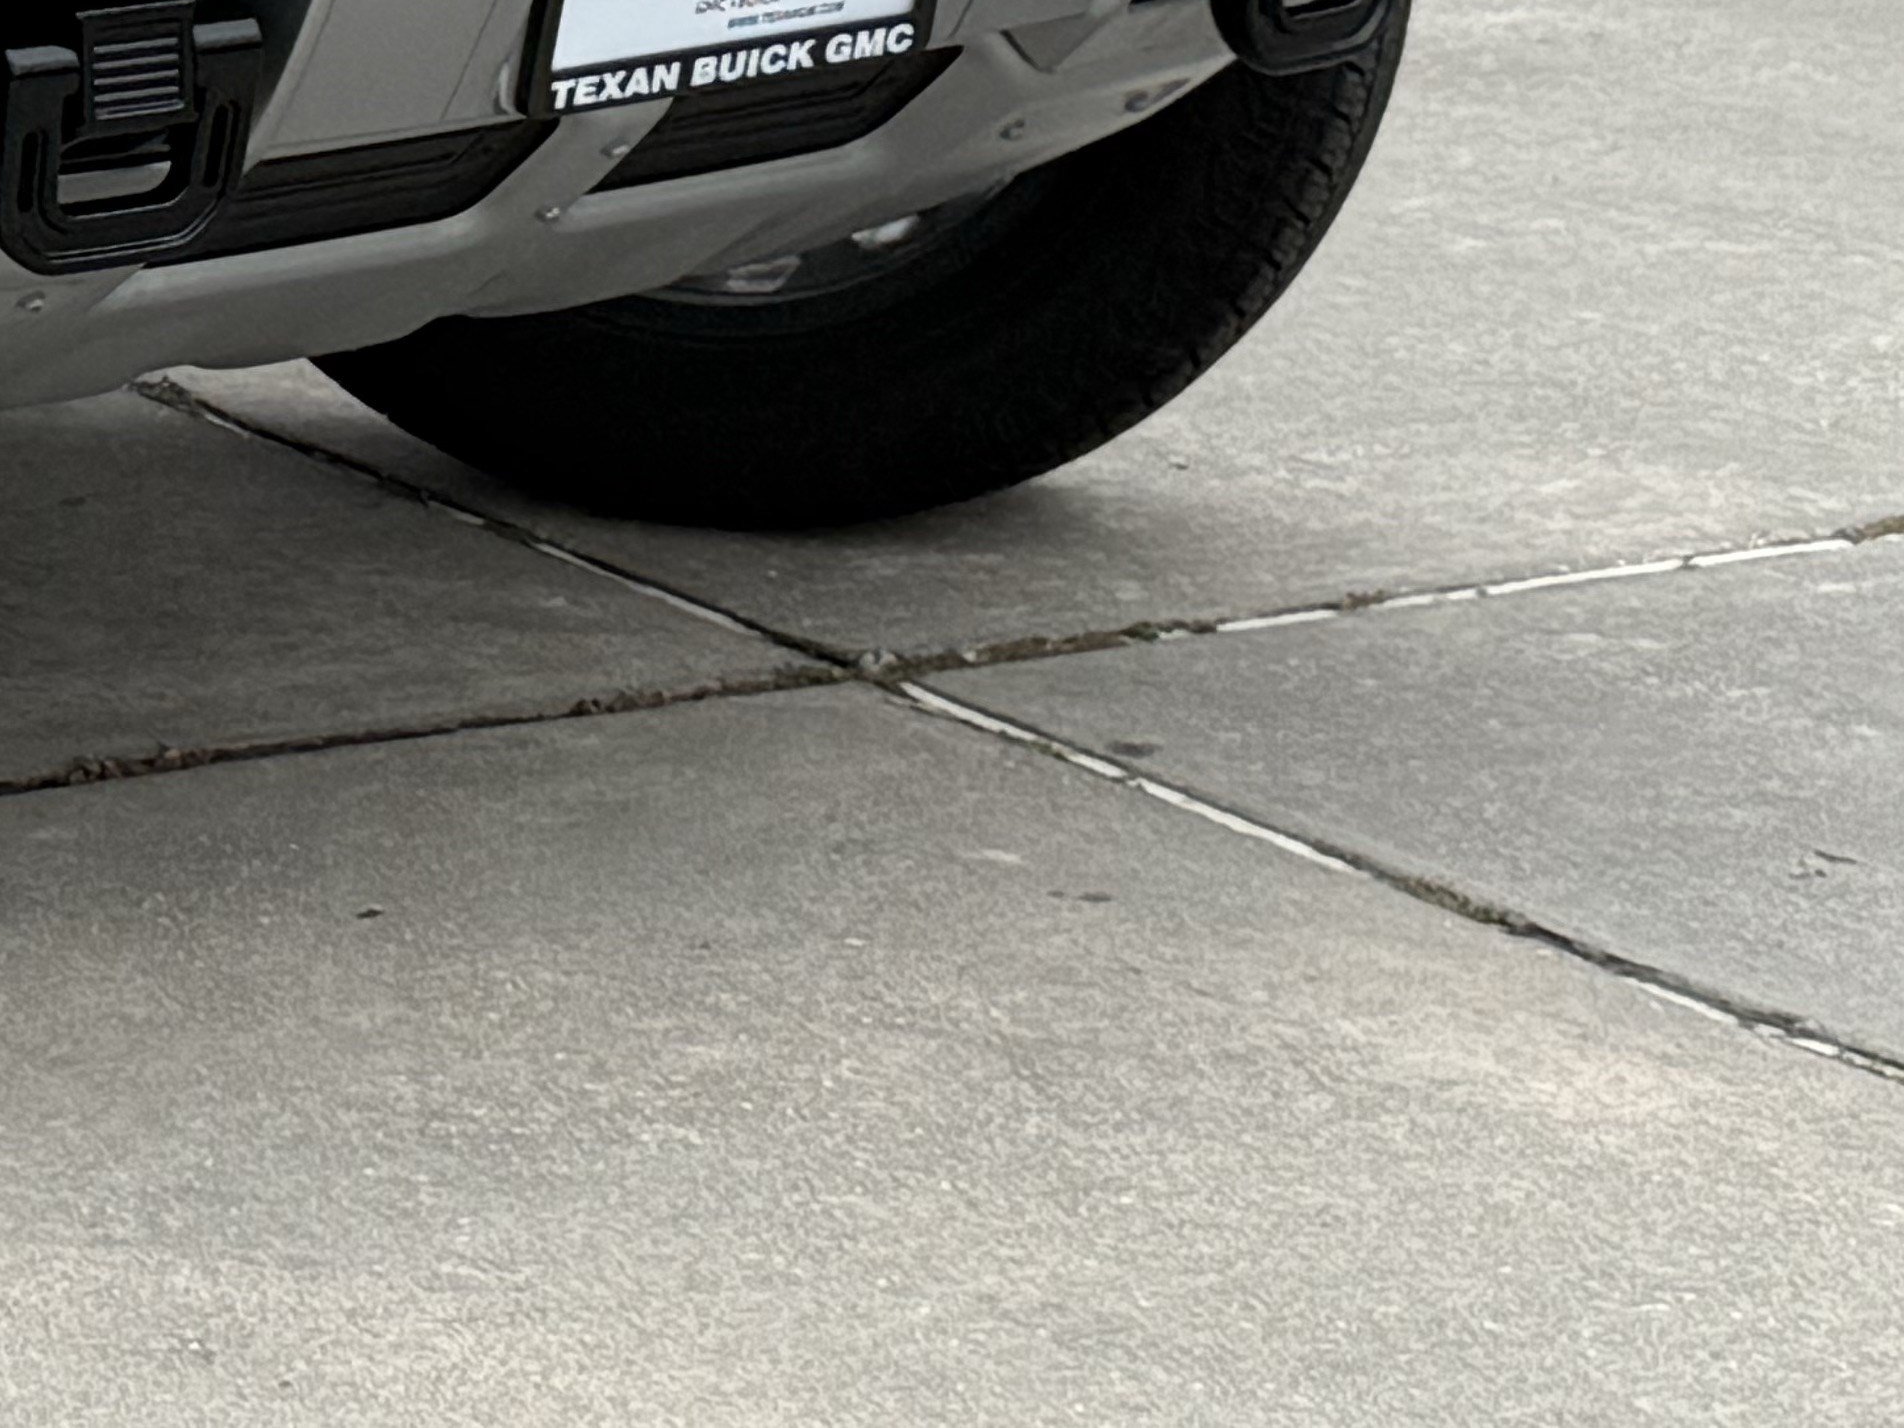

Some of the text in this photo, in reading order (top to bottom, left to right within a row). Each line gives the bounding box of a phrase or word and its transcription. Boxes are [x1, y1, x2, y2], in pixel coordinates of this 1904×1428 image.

[550, 22, 916, 111] TEXAN BUICK GMC
